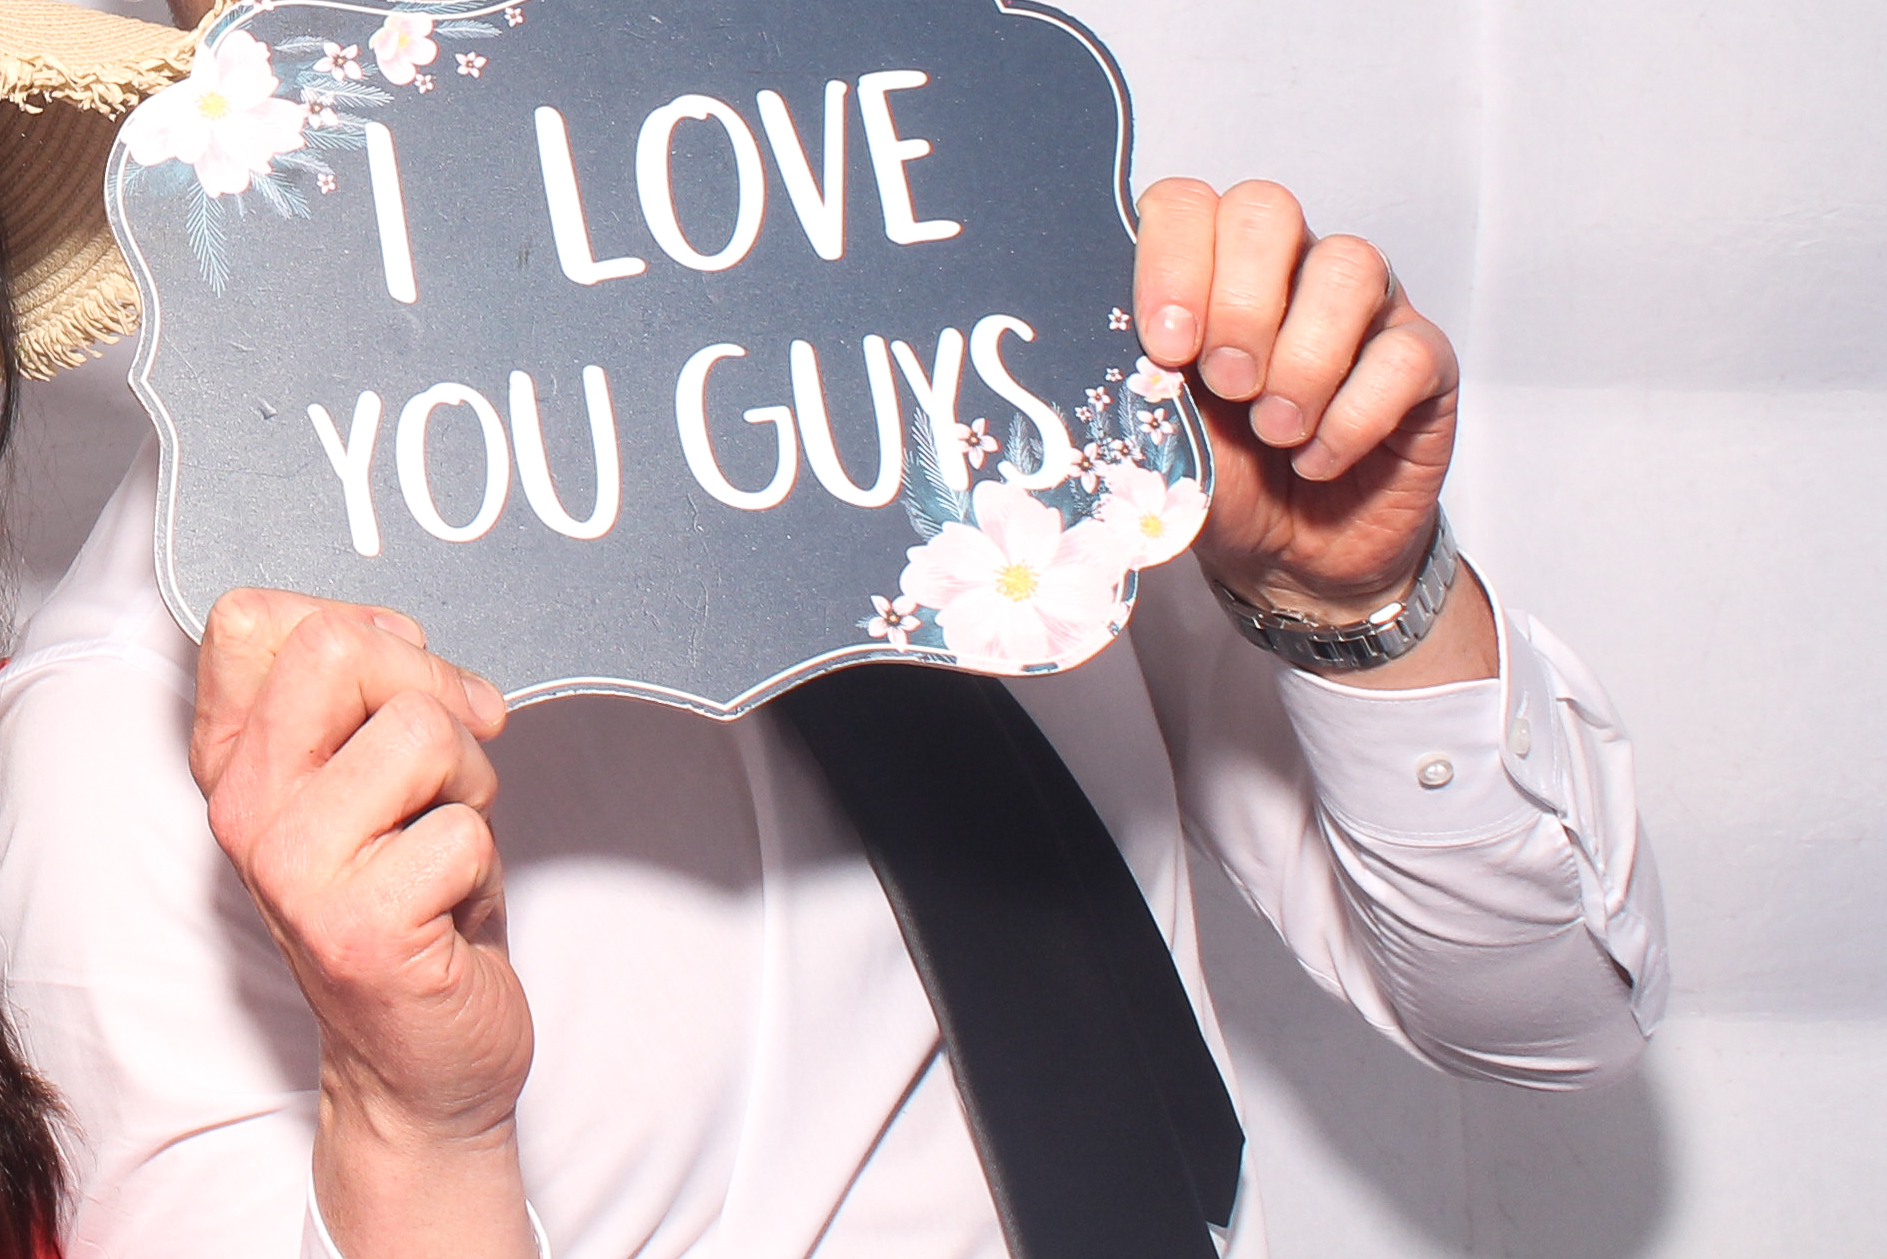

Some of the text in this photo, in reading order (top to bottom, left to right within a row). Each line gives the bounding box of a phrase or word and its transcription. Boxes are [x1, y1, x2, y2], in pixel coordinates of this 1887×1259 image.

[365, 69, 961, 304] I LOVE
[307, 314, 1070, 557] YOU GUYS
